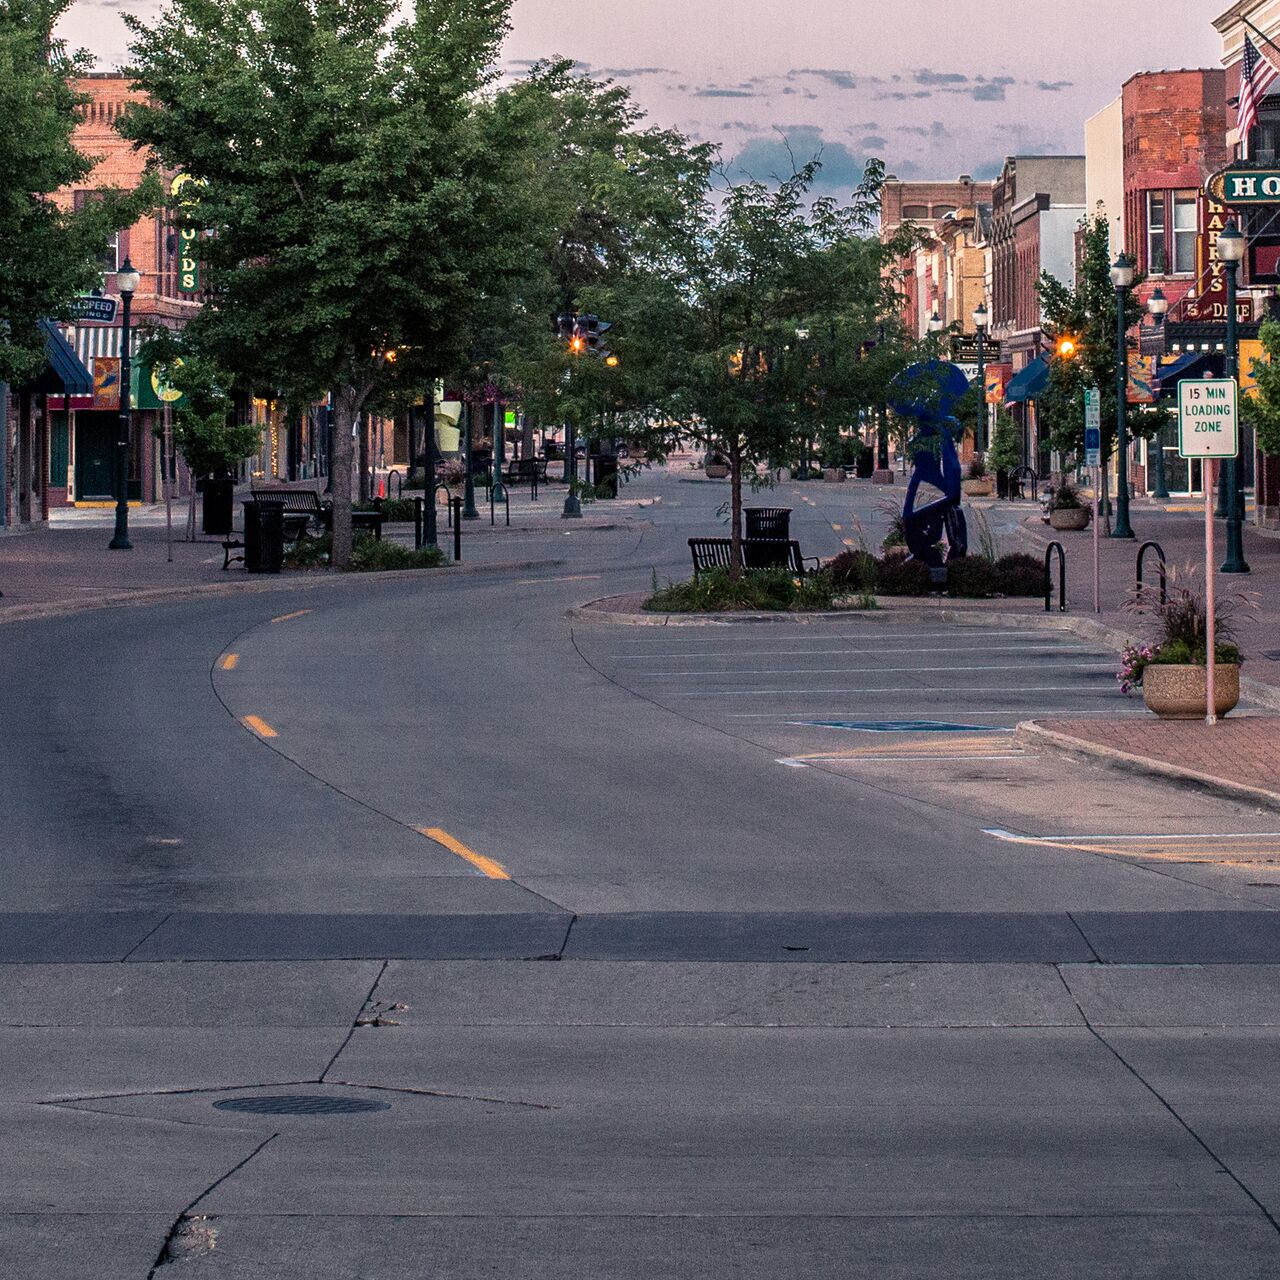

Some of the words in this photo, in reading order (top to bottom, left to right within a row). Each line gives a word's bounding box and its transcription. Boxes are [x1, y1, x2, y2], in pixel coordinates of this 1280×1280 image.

[1189, 388, 1200, 400] 15
[1206, 387, 1226, 399] MIN
[1185, 404, 1231, 416] LOADING
[1194, 421, 1222, 433] ZONE
